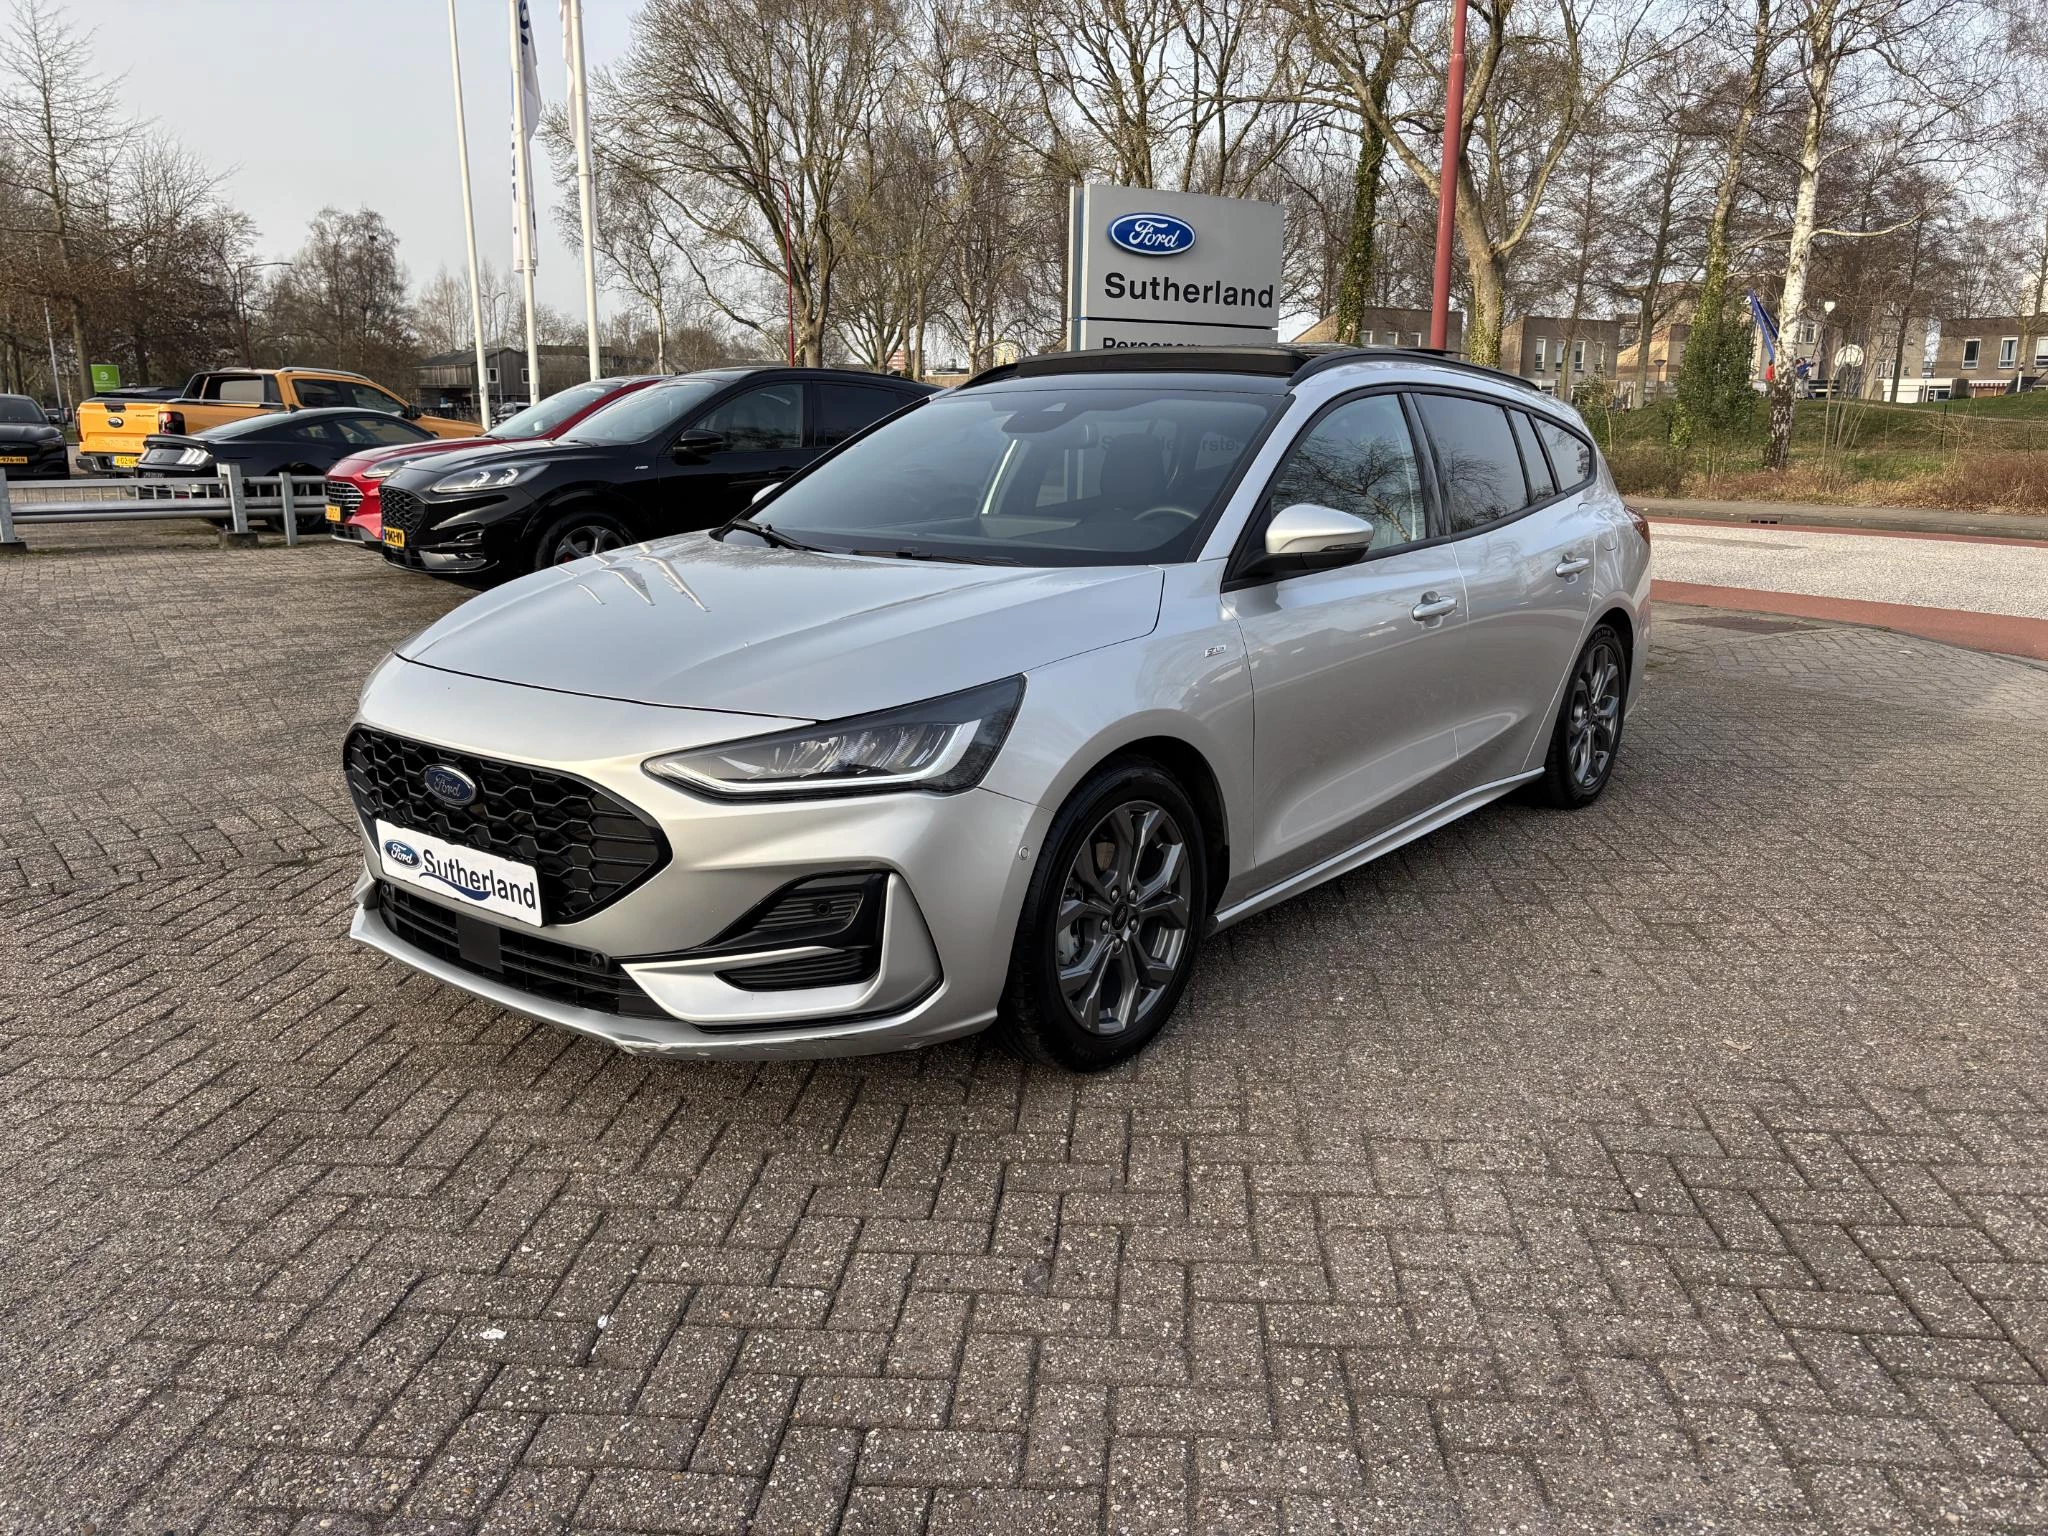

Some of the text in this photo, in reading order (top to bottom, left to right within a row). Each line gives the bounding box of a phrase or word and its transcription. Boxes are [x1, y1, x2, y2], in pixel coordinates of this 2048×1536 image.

[1128, 219, 1180, 248] Ford
[1104, 272, 1274, 308] Sutherland
[433, 773, 461, 797] Ford
[390, 843, 537, 910] Ford Sutherland
